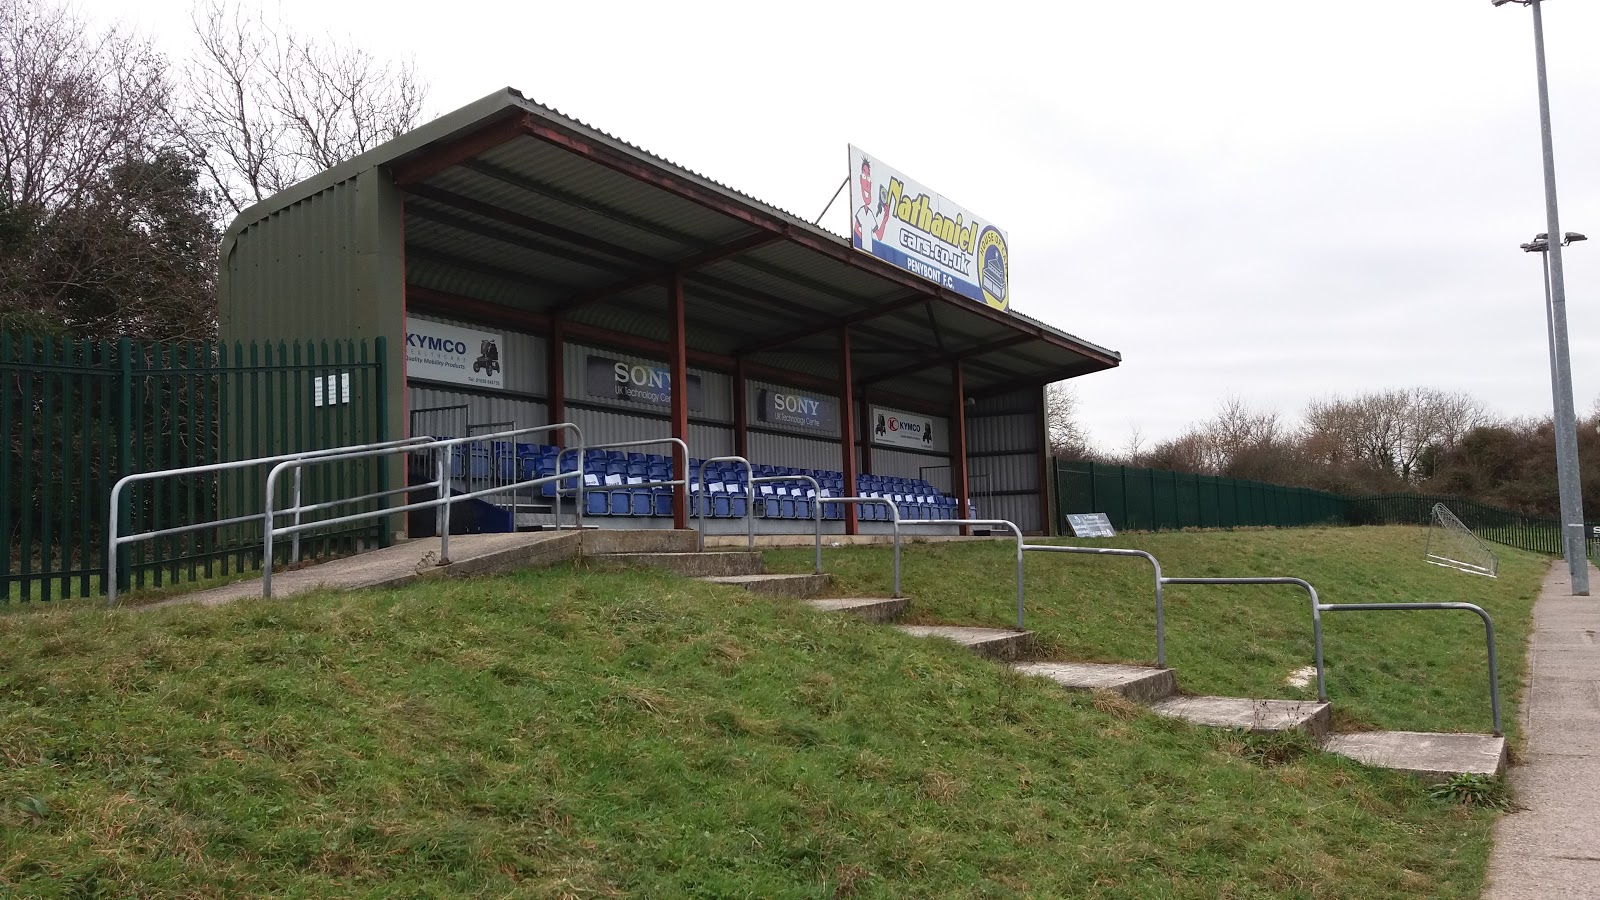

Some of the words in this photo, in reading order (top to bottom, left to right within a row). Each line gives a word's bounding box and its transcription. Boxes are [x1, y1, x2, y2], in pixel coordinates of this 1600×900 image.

[887, 176, 979, 256] Nathaniel
[900, 227, 971, 277] cars.co.uk
[980, 232, 994, 256] HOUSE
[995, 235, 1001, 246] OF
[907, 258, 942, 285] PENYBONT
[942, 273, 955, 289] F.C.
[405, 332, 467, 355] KYMCO
[424, 358, 445, 367] Mobility
[445, 361, 465, 370] Products
[614, 384, 623, 395] UK
[624, 386, 660, 403] Technology
[774, 393, 820, 416] SONY
[781, 412, 805, 427] Technology
[899, 421, 921, 433] KYMCO
